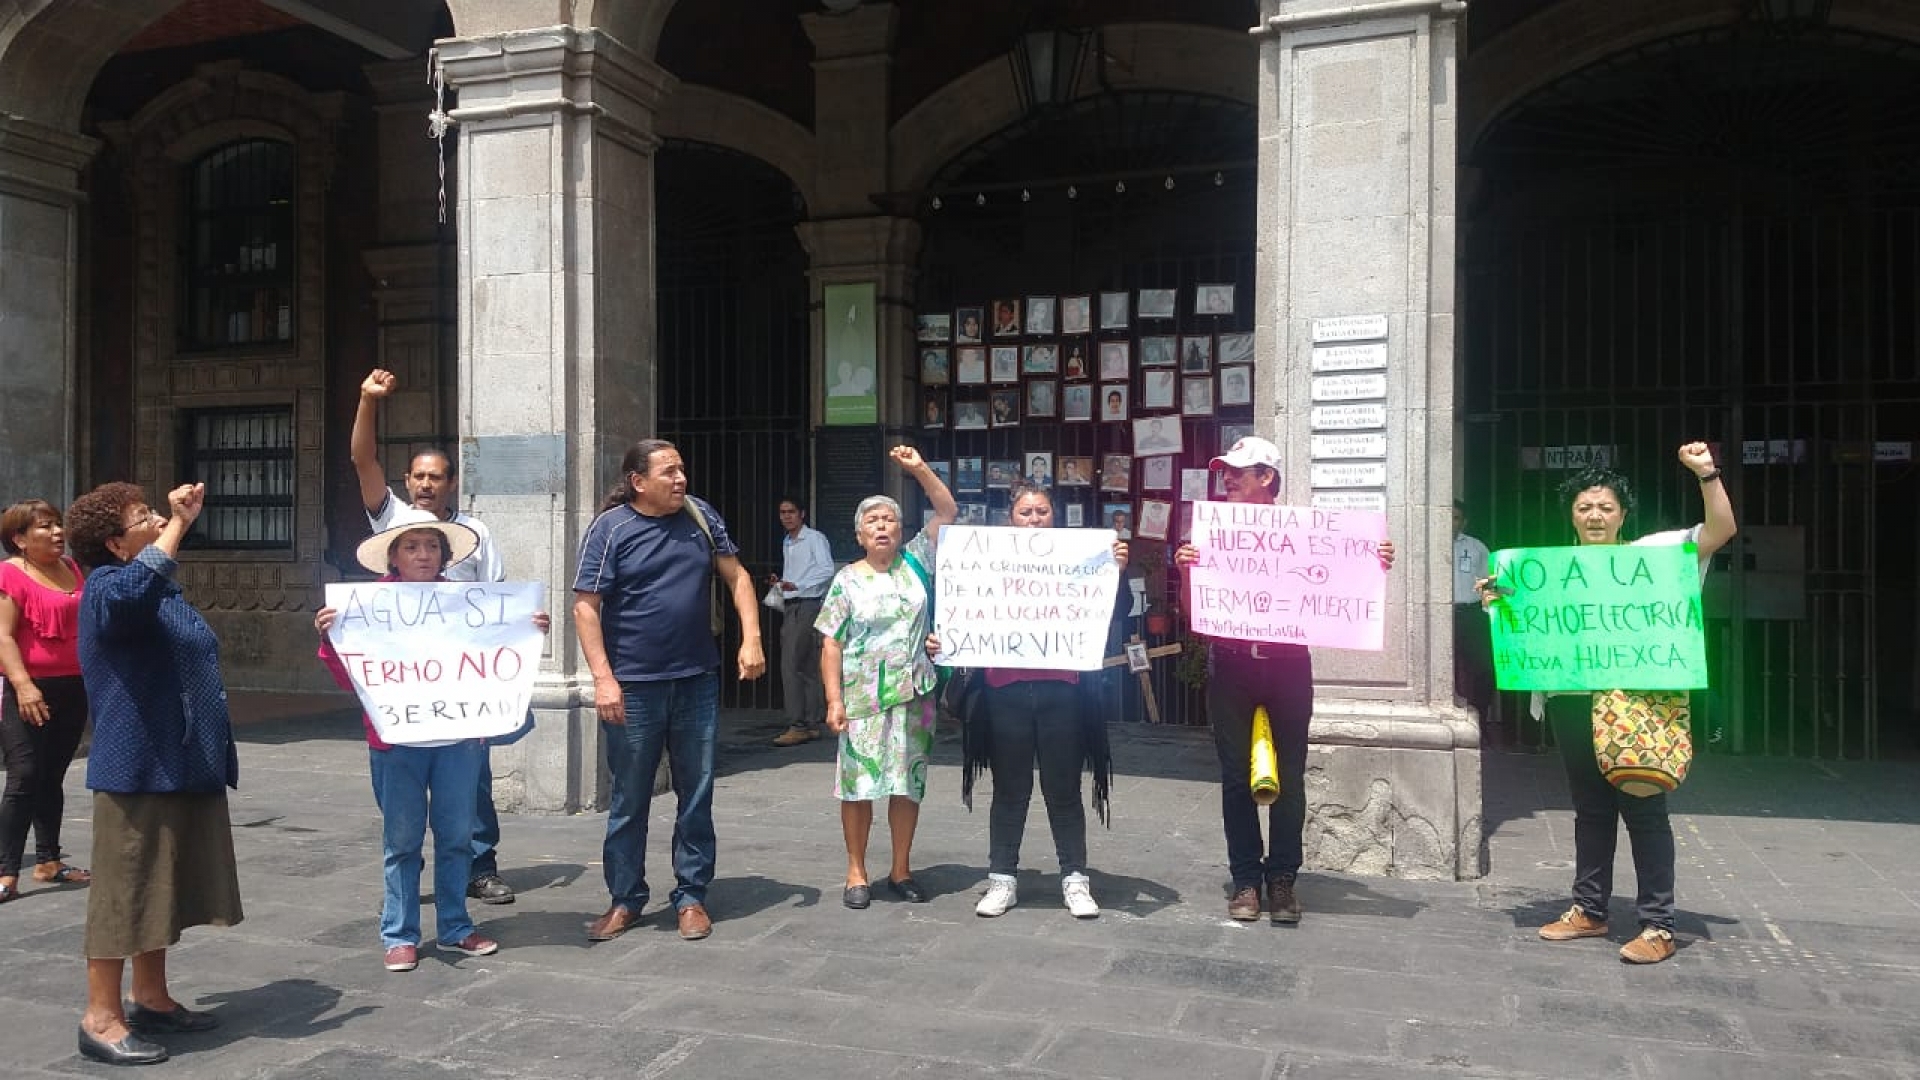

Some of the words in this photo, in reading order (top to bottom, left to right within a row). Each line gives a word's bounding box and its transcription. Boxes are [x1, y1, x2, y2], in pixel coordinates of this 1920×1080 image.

[1199, 504, 1222, 526] LA
[1232, 506, 1299, 529] LUCHA
[1312, 511, 1341, 532] DE
[1209, 528, 1296, 556] HUEXCA
[1307, 535, 1336, 557] ES
[1341, 537, 1379, 559] POR
[940, 561, 953, 571] A
[960, 561, 982, 571] LA
[1496, 558, 1547, 592] NO
[1560, 555, 1588, 589] A
[1610, 554, 1654, 587] LA
[944, 577, 968, 598] DE
[977, 585, 995, 598] LA
[1002, 576, 1104, 599] PROTESTA
[340, 587, 446, 632] AGUA
[464, 587, 518, 628] SI
[945, 606, 957, 624] Y
[965, 607, 985, 621] LA
[993, 604, 1061, 622] LUCHA
[1298, 593, 1382, 625] MUERTE
[1499, 597, 1703, 635] TERMOELECTRICA
[338, 653, 443, 687] TERMO
[457, 646, 522, 682] NO
[1572, 642, 1688, 674] HUEXCA
